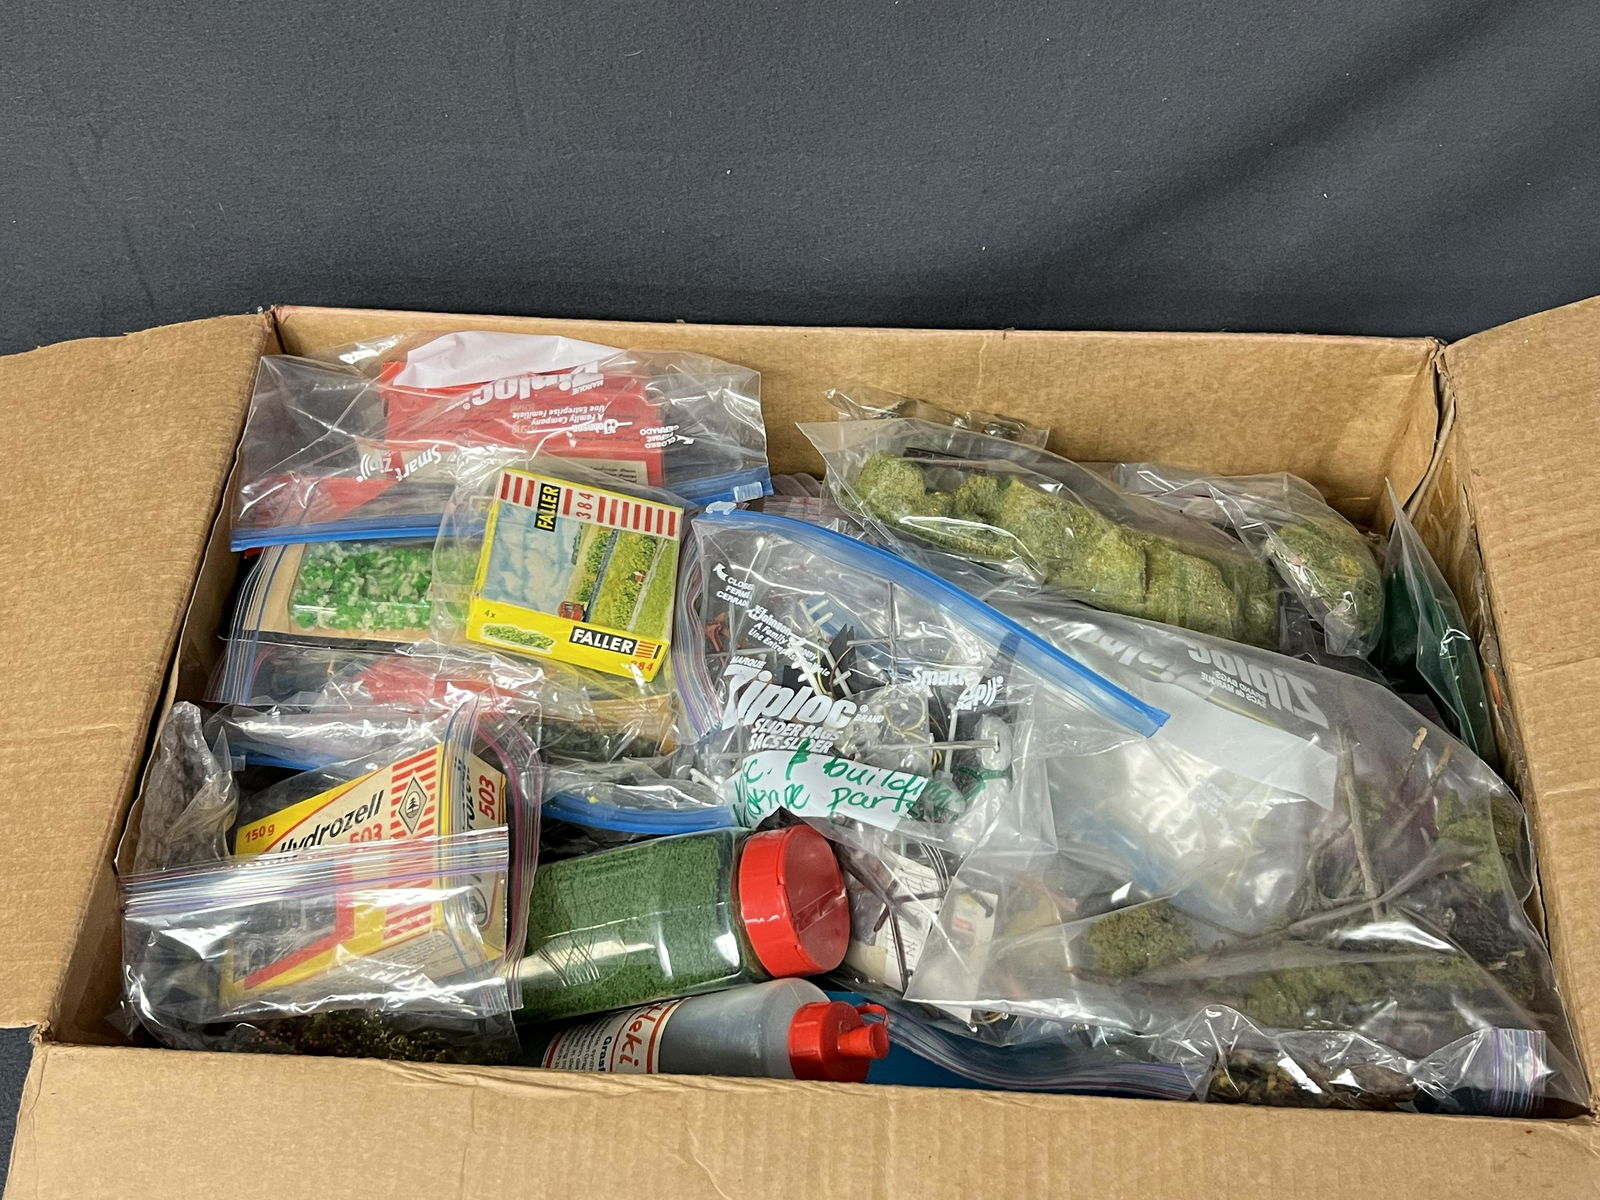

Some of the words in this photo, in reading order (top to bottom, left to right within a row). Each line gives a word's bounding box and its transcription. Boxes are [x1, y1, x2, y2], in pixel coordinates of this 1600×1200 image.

[531, 417, 568, 425] Company
[395, 444, 441, 481] Smart
[537, 484, 560, 530] FALLER
[576, 491, 594, 519] 384
[484, 610, 496, 619] 4x
[572, 628, 634, 654] FALLER
[748, 628, 763, 640] Une
[754, 622, 763, 630] A
[762, 625, 789, 645] Family
[730, 656, 767, 669] MARQUE
[722, 664, 857, 730] Ziploc
[751, 718, 804, 737] SLIDER
[801, 724, 844, 741] BAGS
[748, 733, 779, 751] SACS
[780, 736, 834, 753] SLDER
[479, 775, 496, 820] 503
[244, 826, 266, 842] 150
[267, 824, 275, 836] g
[350, 823, 383, 844] 503
[619, 1003, 663, 1067] Heki
